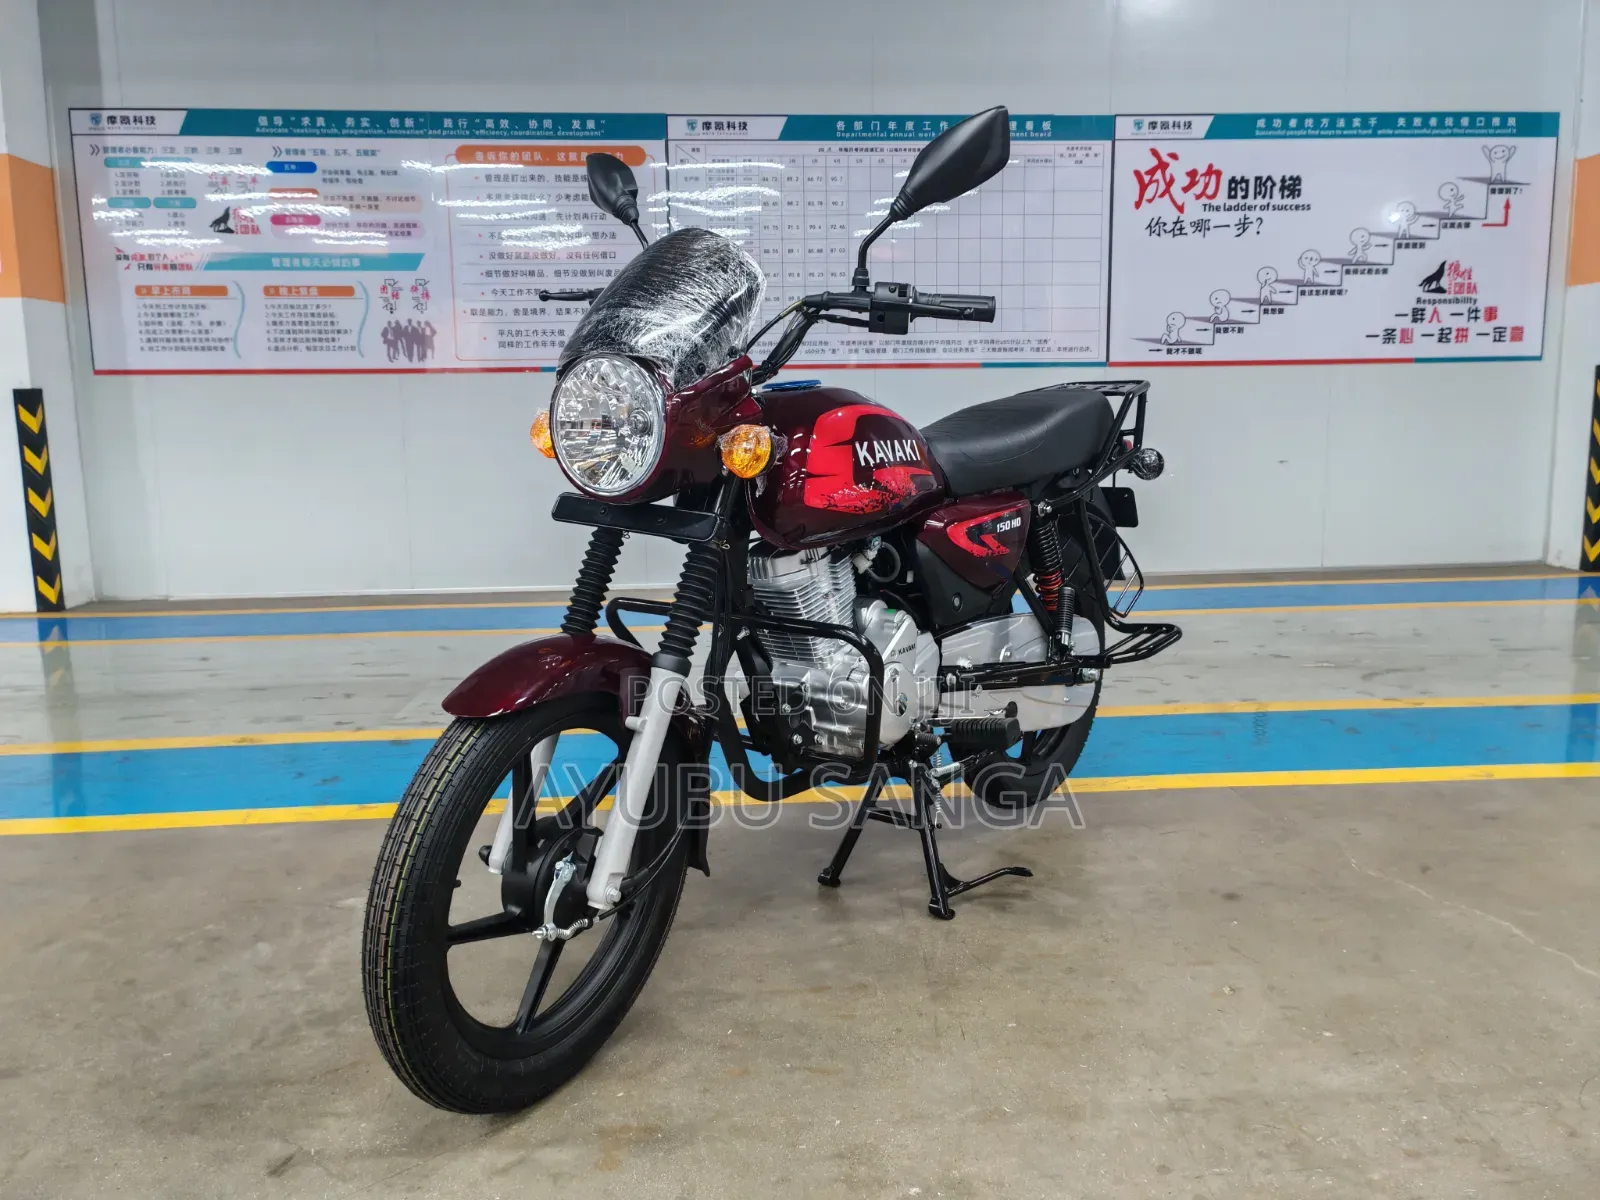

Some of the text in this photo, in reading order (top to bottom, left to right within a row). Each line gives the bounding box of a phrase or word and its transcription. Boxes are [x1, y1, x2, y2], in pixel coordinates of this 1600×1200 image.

[1202, 202, 1311, 212] The ladder of success
[1395, 306, 1498, 323] 一群人 一件事
[1365, 327, 1414, 344] 一条心
[1420, 327, 1469, 344] 一起拼
[855, 439, 921, 466] KAVAKI
[997, 520, 1010, 533] 150
